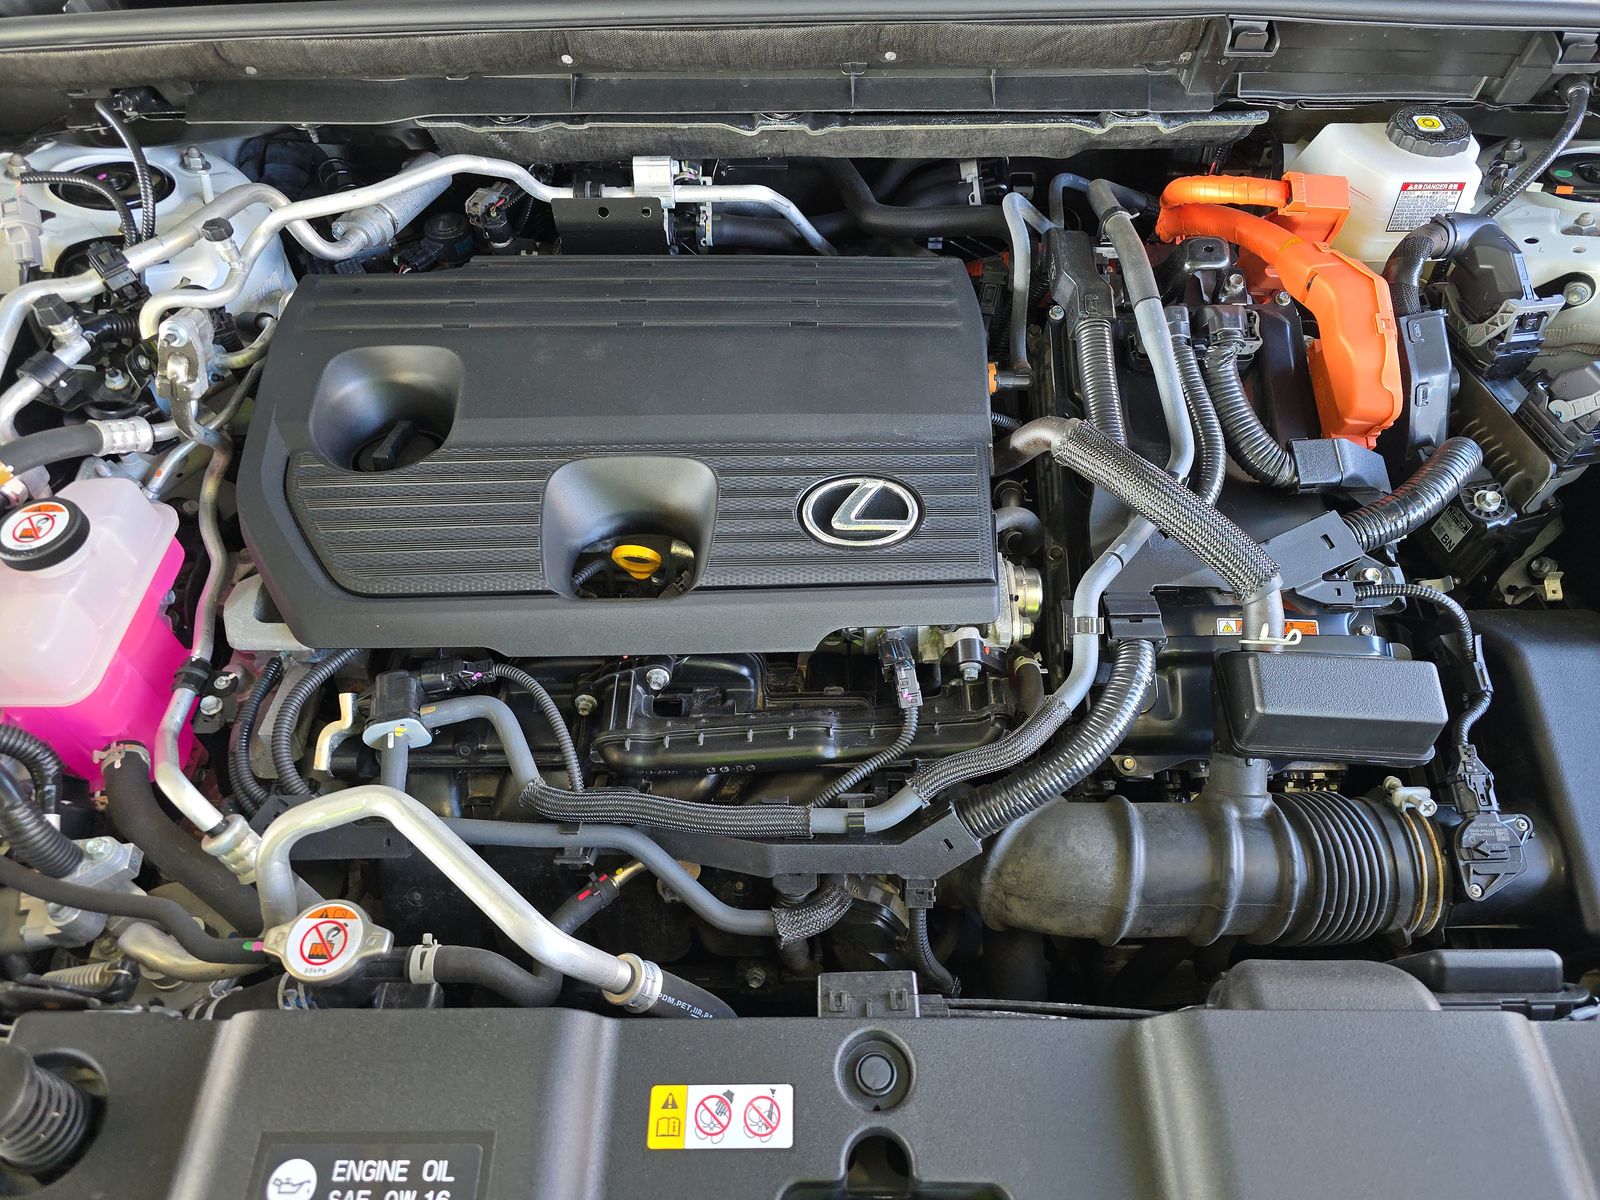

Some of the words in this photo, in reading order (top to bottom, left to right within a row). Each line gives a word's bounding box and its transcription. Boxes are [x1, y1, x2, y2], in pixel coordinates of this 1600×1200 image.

[1440, 532, 1456, 550] BN
[331, 1159, 411, 1183] ENGINE
[421, 1159, 456, 1183] OIL
